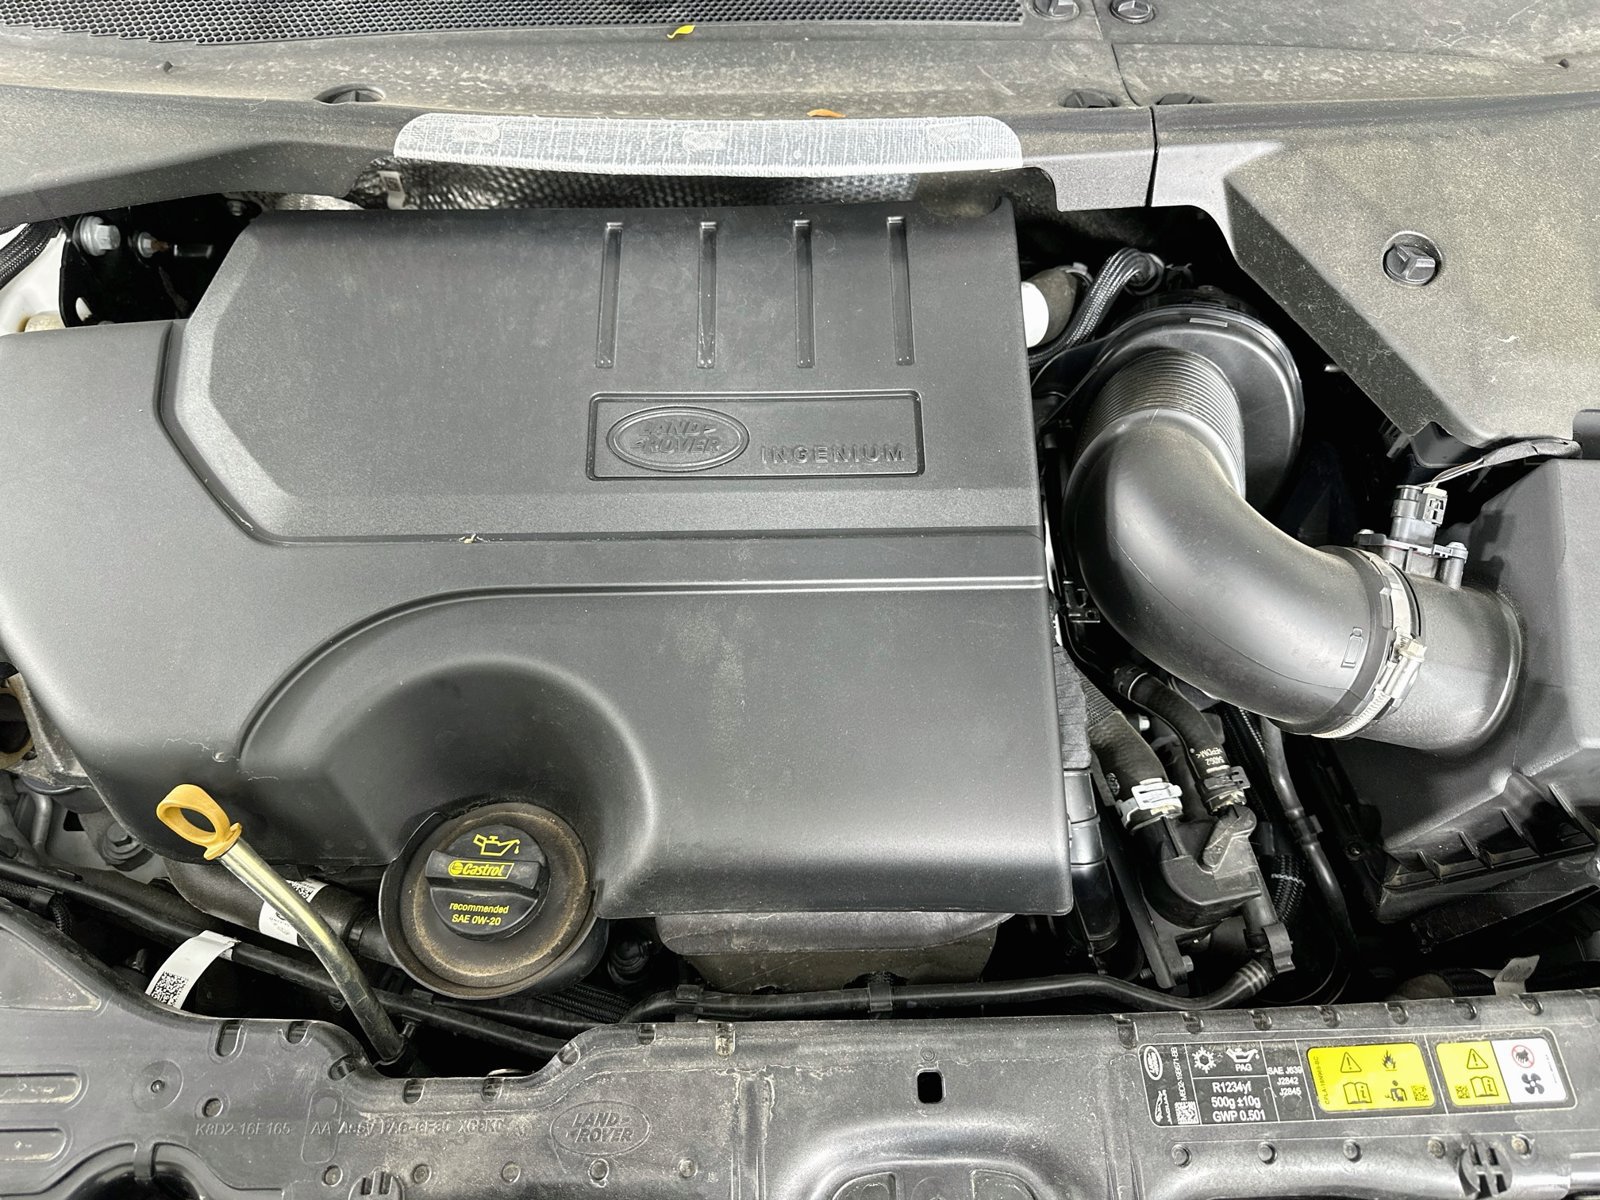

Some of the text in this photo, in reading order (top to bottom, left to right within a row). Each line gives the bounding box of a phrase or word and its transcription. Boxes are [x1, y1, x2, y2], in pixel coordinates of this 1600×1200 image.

[640, 436, 720, 453] ROVER
[759, 446, 906, 464] INGENIUM
[462, 863, 505, 877] Castrol
[449, 902, 510, 914] recommended
[451, 914, 502, 926] SAE 0W-20
[1235, 1064, 1253, 1072] PAG
[1267, 1066, 1303, 1075] SAE J639
[1212, 1081, 1252, 1093] R1234yf
[1277, 1077, 1299, 1085] J2842
[1211, 1096, 1261, 1108] 500g ±10g
[1212, 1110, 1266, 1122] GWP 0.501
[572, 1112, 634, 1143] LAND ROVER
